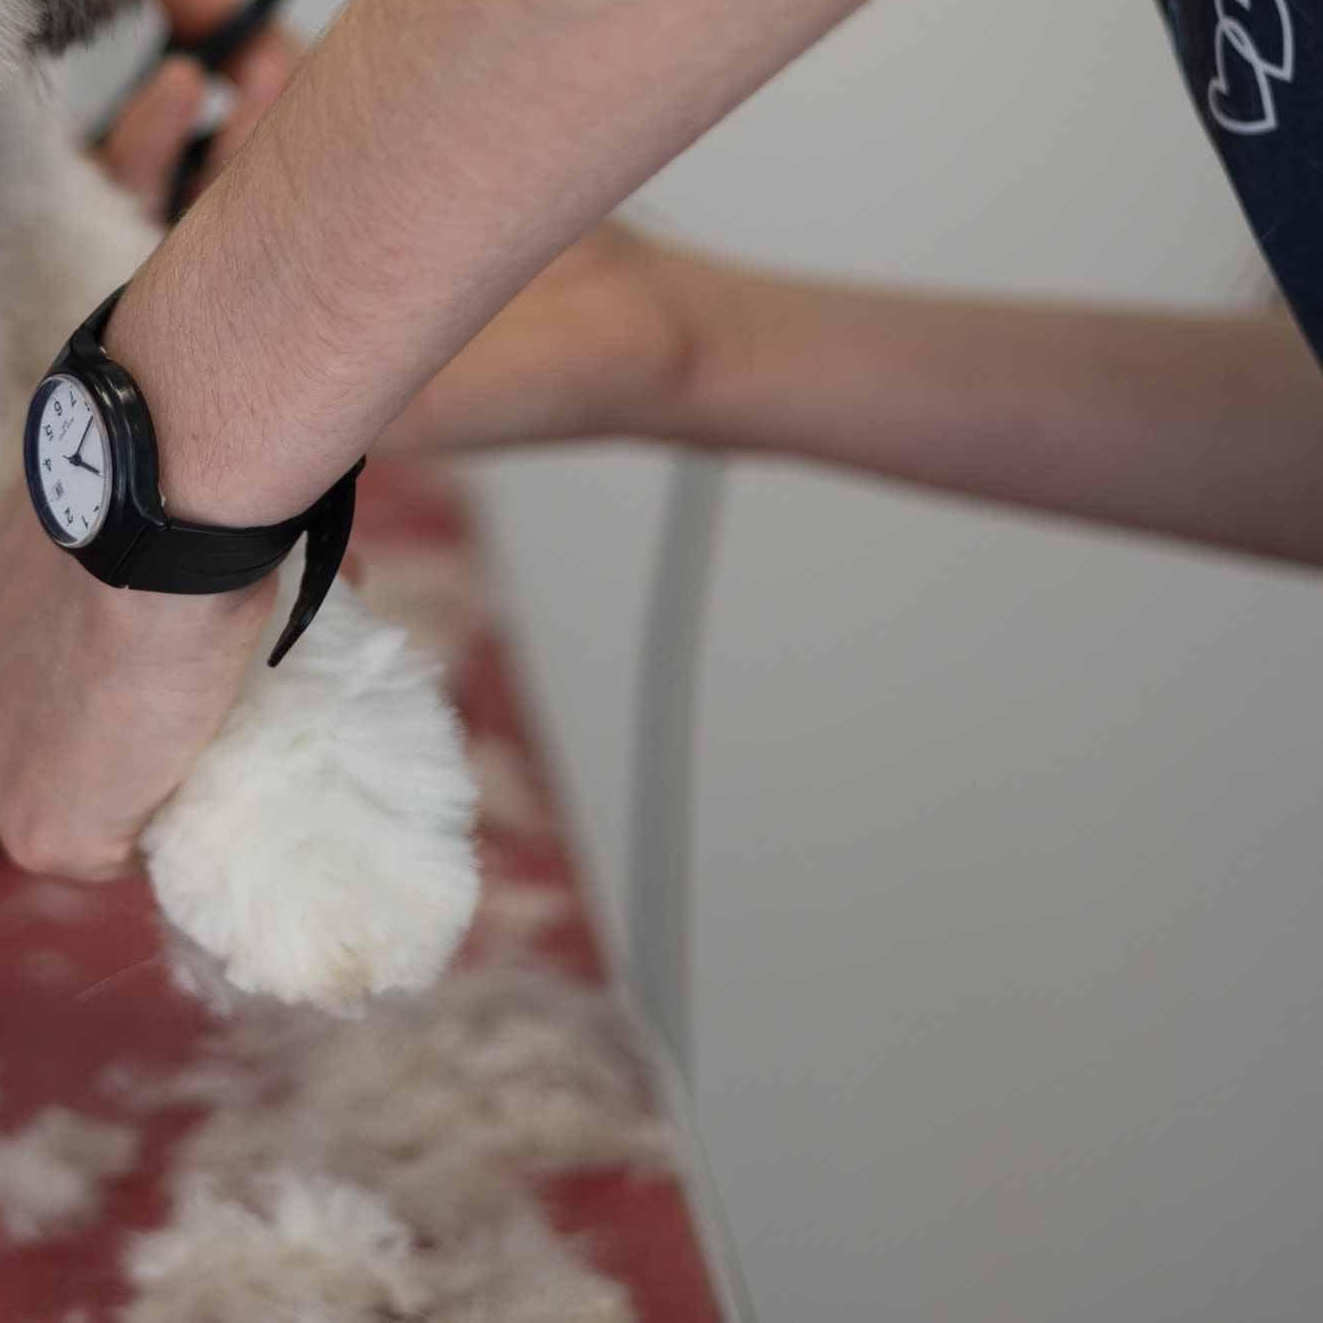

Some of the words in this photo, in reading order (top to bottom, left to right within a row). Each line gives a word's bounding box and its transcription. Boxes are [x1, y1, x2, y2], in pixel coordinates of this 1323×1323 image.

[53, 400, 62, 417] 6
[43, 424, 54, 441] 5
[42, 457, 52, 472] 4
[64, 506, 74, 526] 2
